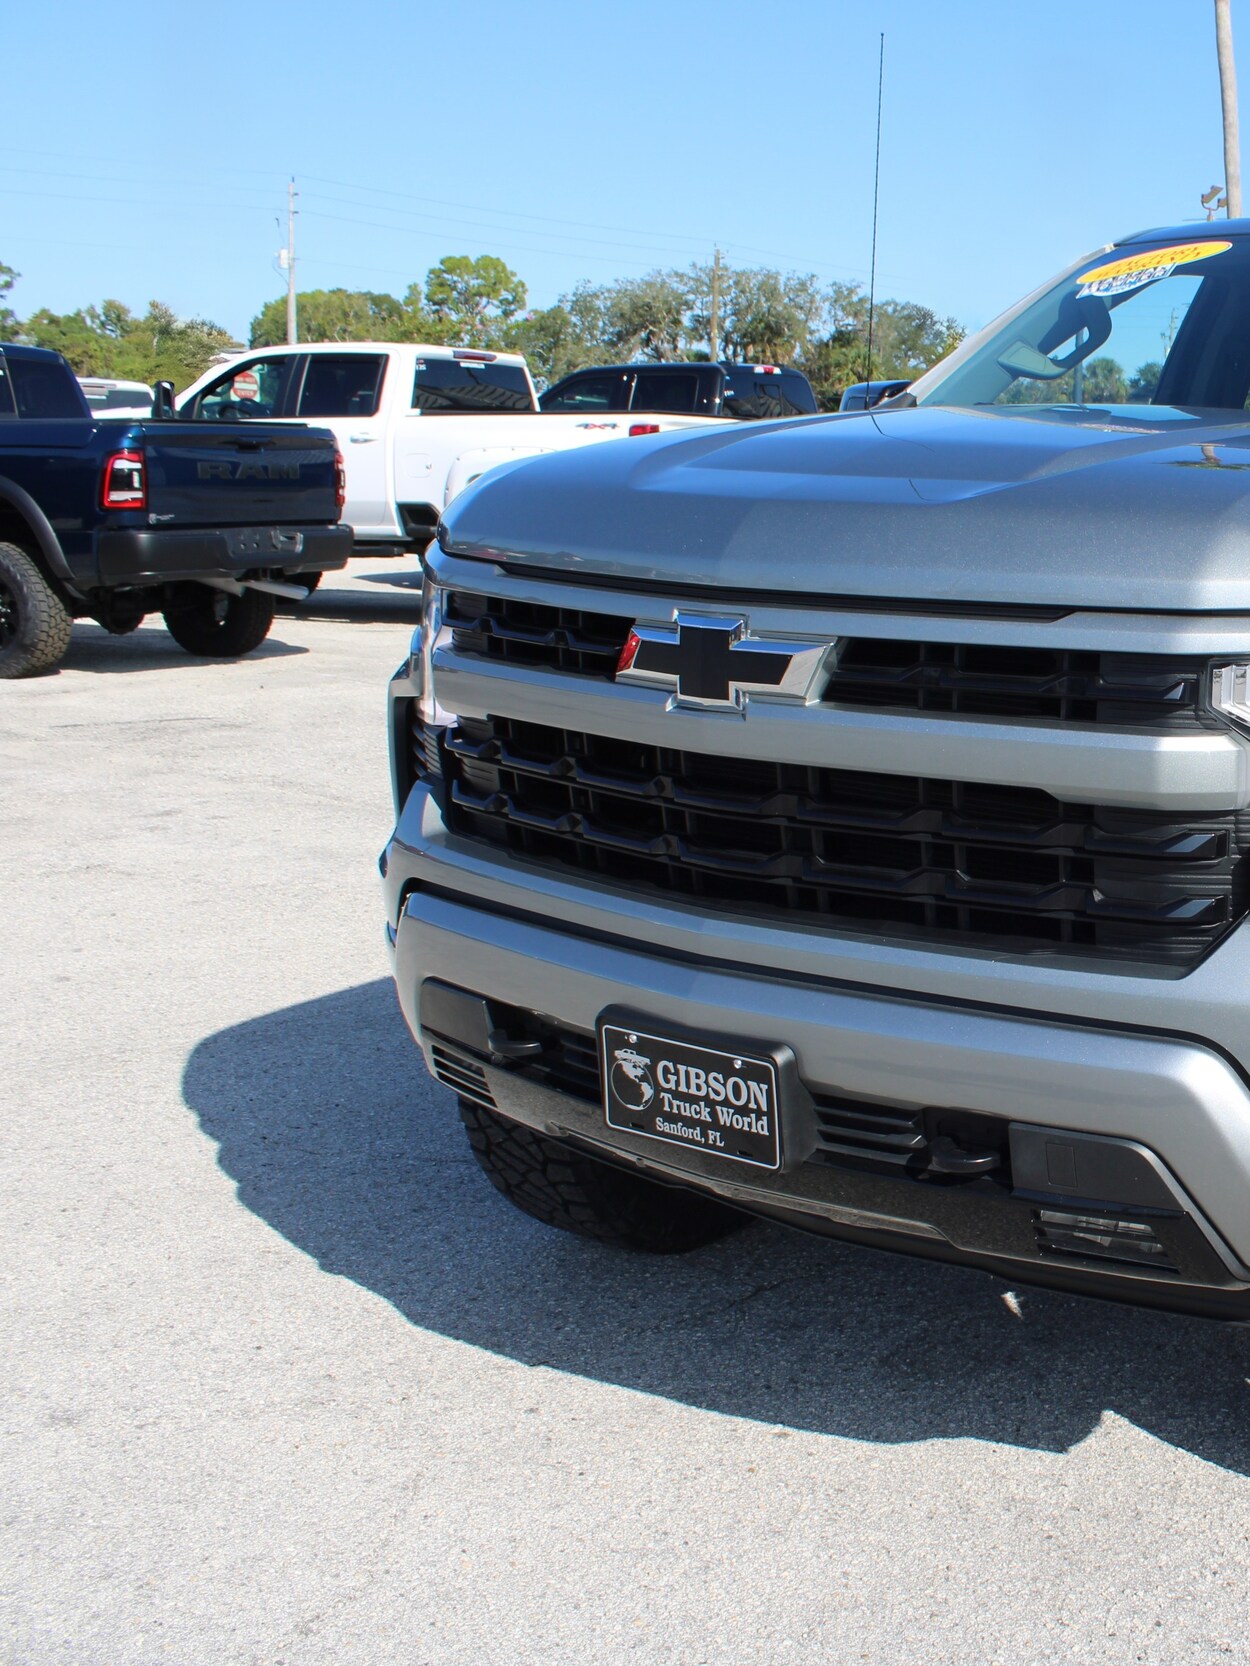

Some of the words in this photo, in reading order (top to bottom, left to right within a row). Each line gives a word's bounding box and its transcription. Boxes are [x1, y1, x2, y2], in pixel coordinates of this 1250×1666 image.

[197, 462, 300, 479] RAM
[656, 1060, 768, 1112] GIBSON
[655, 1117, 705, 1144] Sanford,
[708, 1130, 725, 1147] FL
[660, 1092, 712, 1122] Truck
[716, 1105, 769, 1136] World
